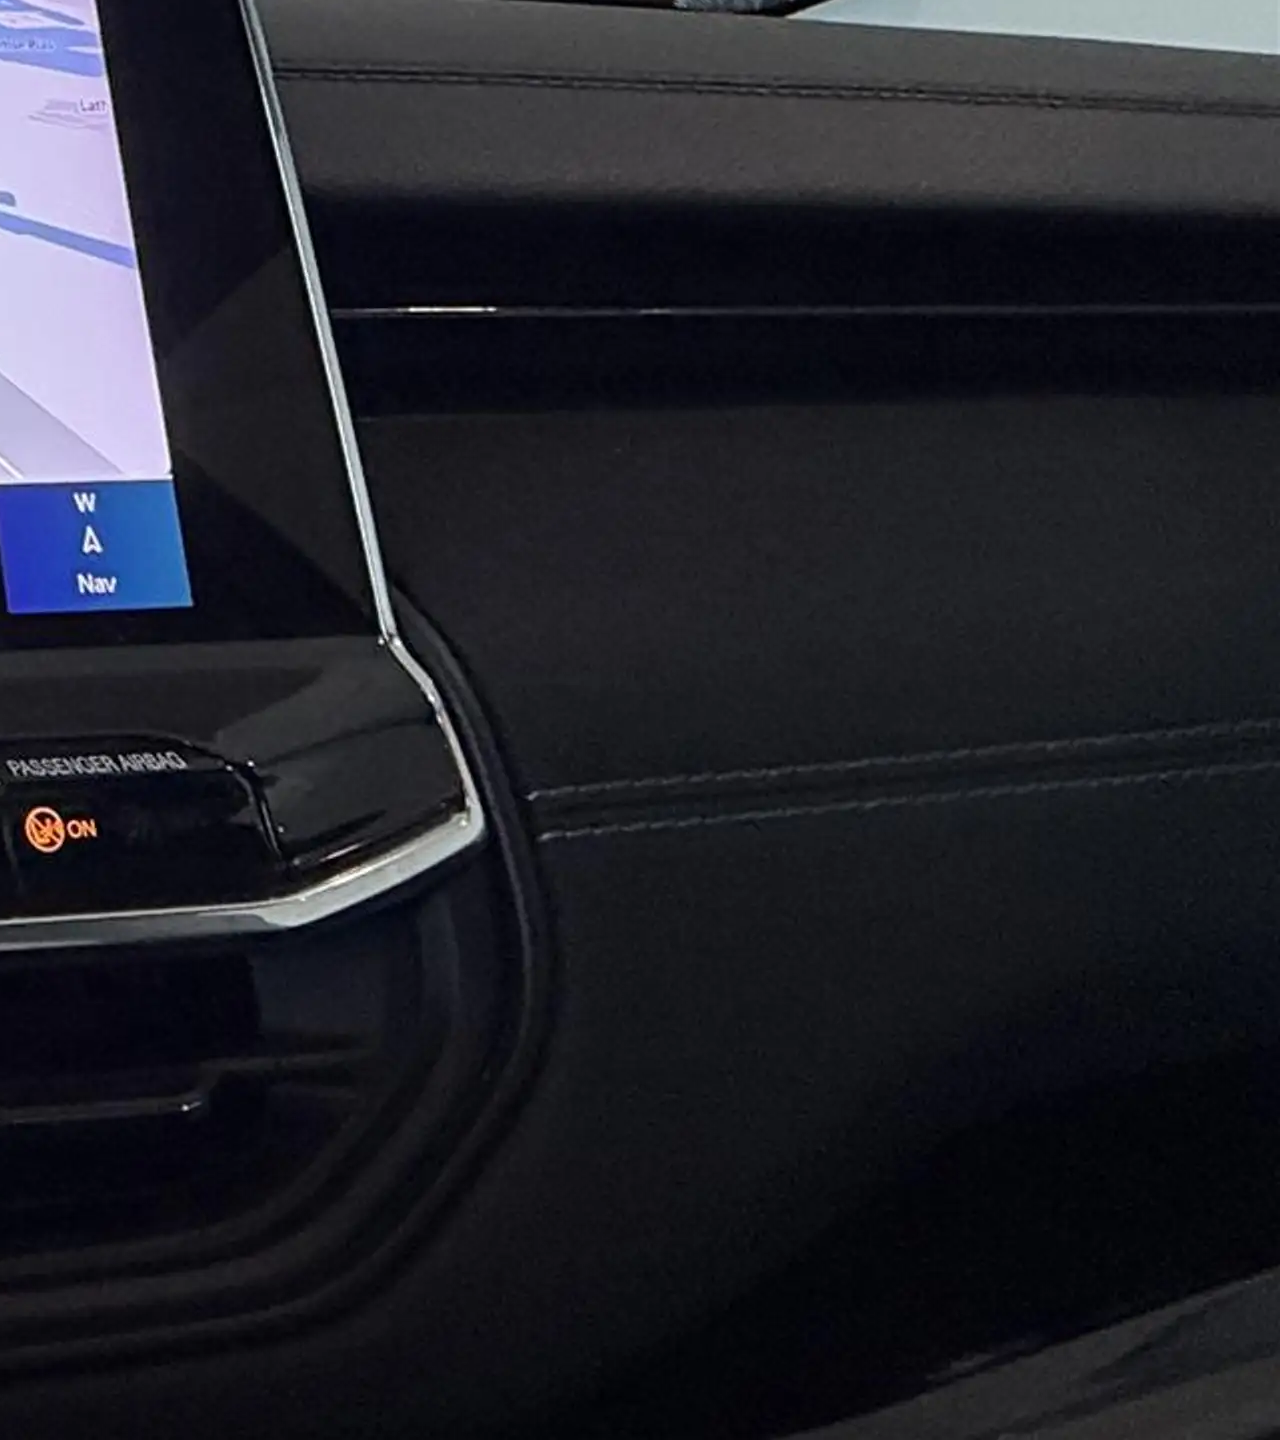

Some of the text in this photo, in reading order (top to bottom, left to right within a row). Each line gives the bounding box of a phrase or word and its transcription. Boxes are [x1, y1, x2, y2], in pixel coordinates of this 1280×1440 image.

[72, 492, 97, 514] W
[77, 573, 117, 596] Nav
[6, 750, 188, 779] PASSENGER AIRBAG
[65, 818, 98, 839] ON
